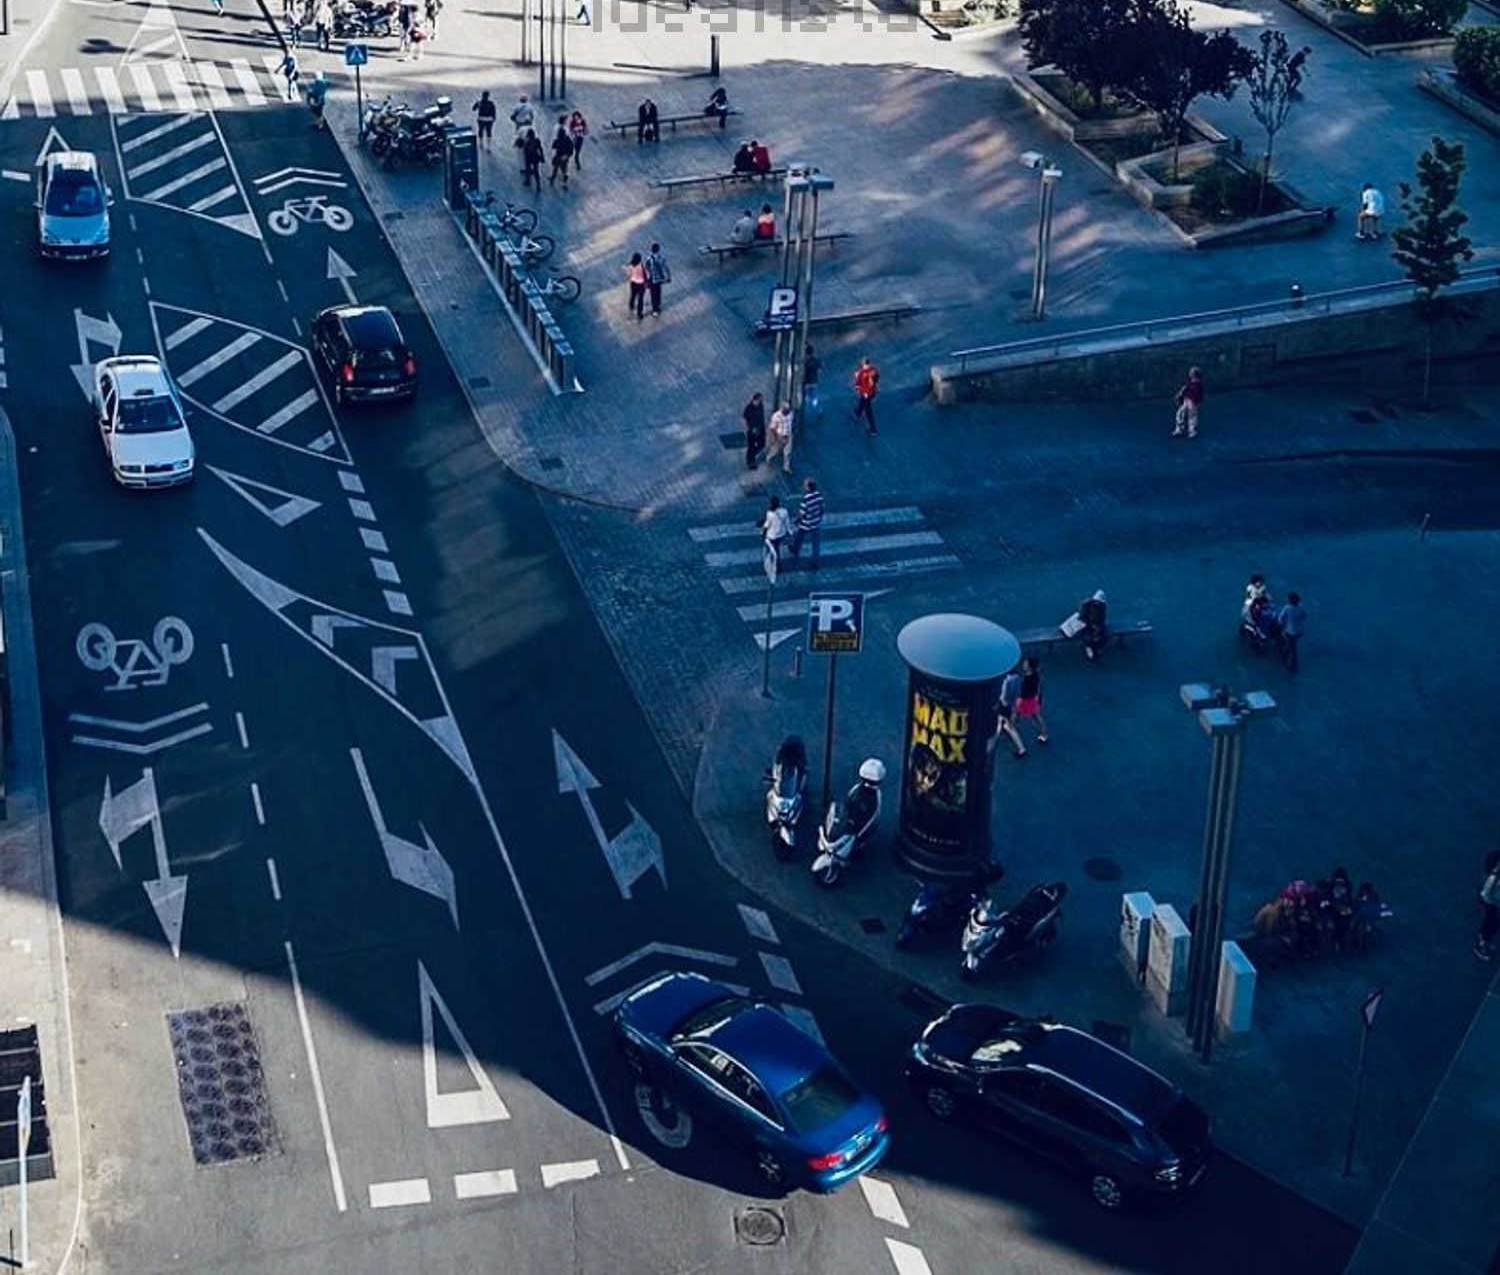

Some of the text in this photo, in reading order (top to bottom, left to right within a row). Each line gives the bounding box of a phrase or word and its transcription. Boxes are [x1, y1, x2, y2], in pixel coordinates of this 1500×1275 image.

[771, 288, 796, 315] P
[819, 599, 853, 631] P
[913, 692, 969, 736] MAD
[912, 721, 967, 762] MAX
